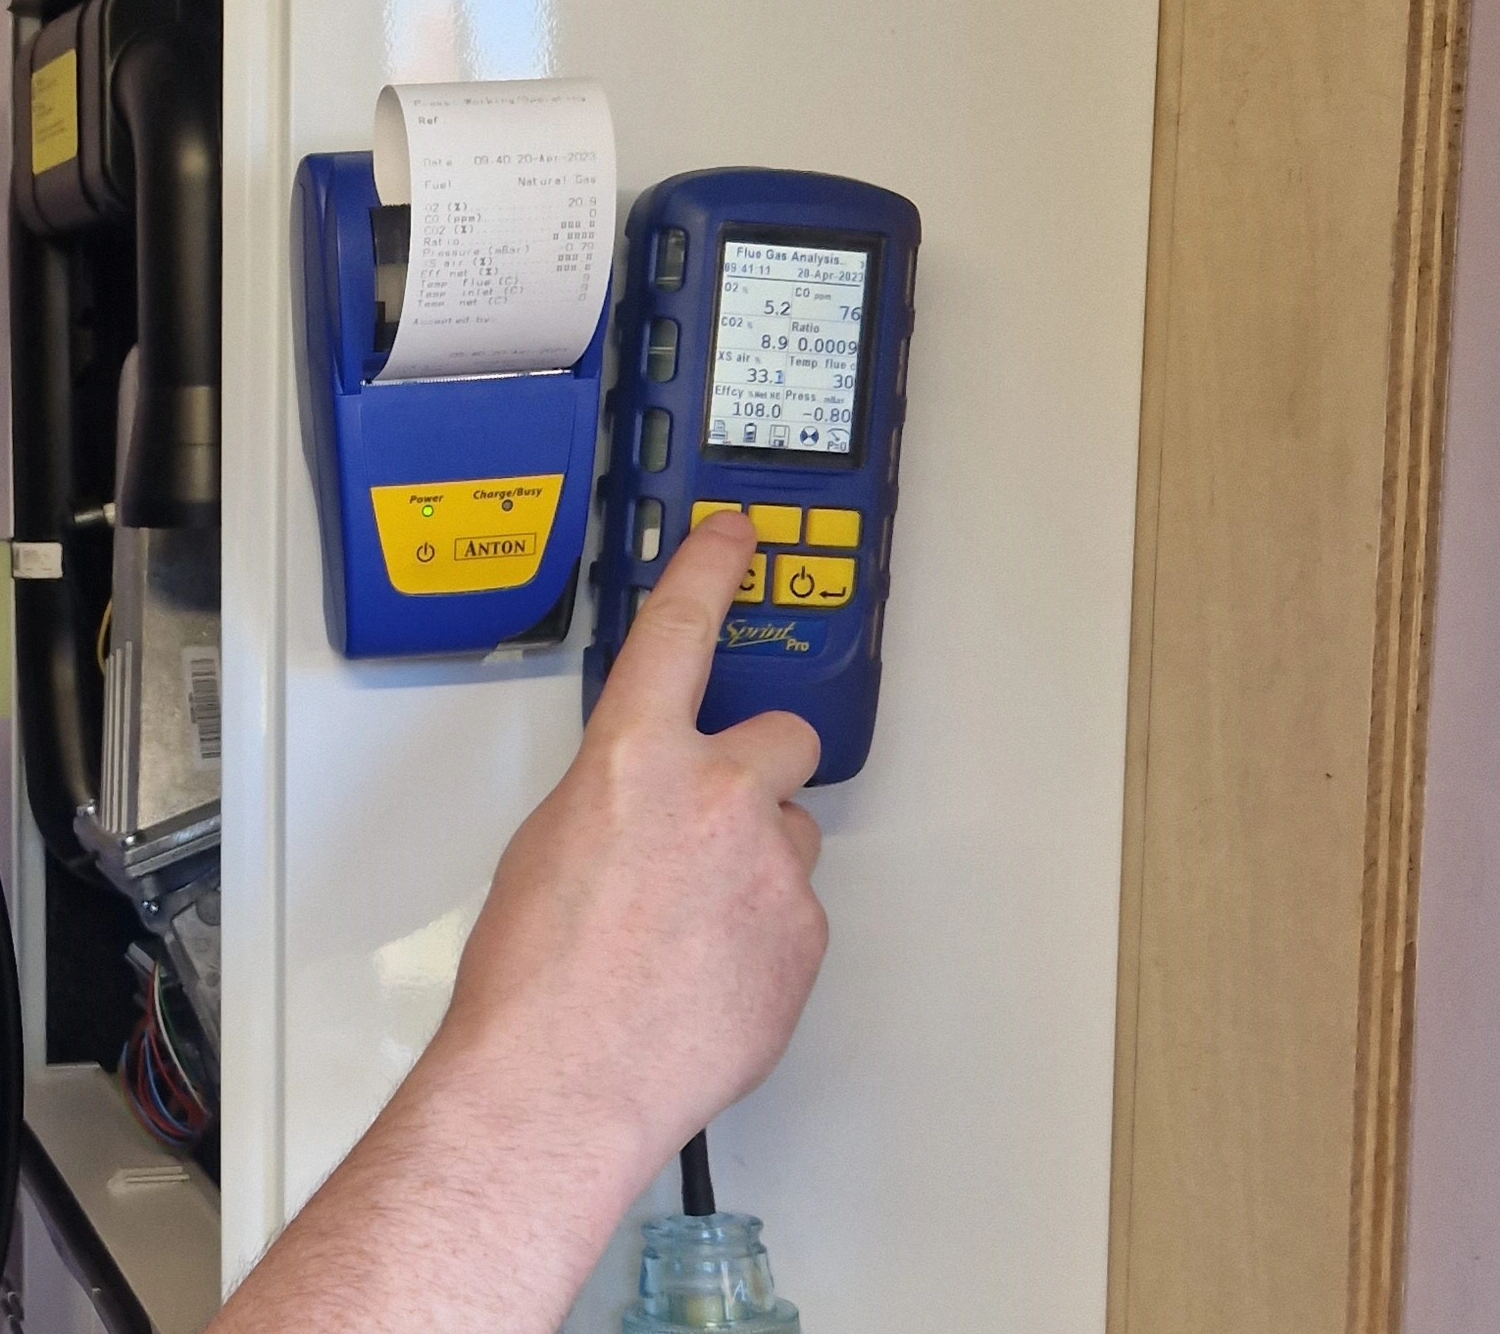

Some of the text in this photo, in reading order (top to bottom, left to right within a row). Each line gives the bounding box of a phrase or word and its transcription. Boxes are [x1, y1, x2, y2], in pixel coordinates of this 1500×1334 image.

[736, 246, 762, 260] Flue
[766, 248, 788, 261] Gas
[794, 287, 811, 299] CO
[763, 299, 791, 317] 5.2
[839, 305, 863, 322] 76
[721, 316, 744, 328] CO2
[791, 321, 820, 334] Ratio
[760, 334, 789, 351] 8.9
[797, 336, 858, 355] 0.0009
[717, 350, 733, 363] XS
[736, 353, 752, 364] air
[789, 355, 819, 370] Temp
[825, 357, 847, 371] flue
[746, 367, 785, 385] 33.1
[832, 373, 855, 390] 30
[715, 385, 745, 400] Effcy
[785, 389, 817, 402] Press
[731, 401, 782, 419] 108.0
[802, 406, 852, 424] -0.80
[409, 494, 444, 505] Power
[472, 487, 543, 501] Charge/Busy
[463, 539, 527, 558] ANTON
[724, 619, 797, 648] Sprint
[785, 637, 810, 653] Pro
